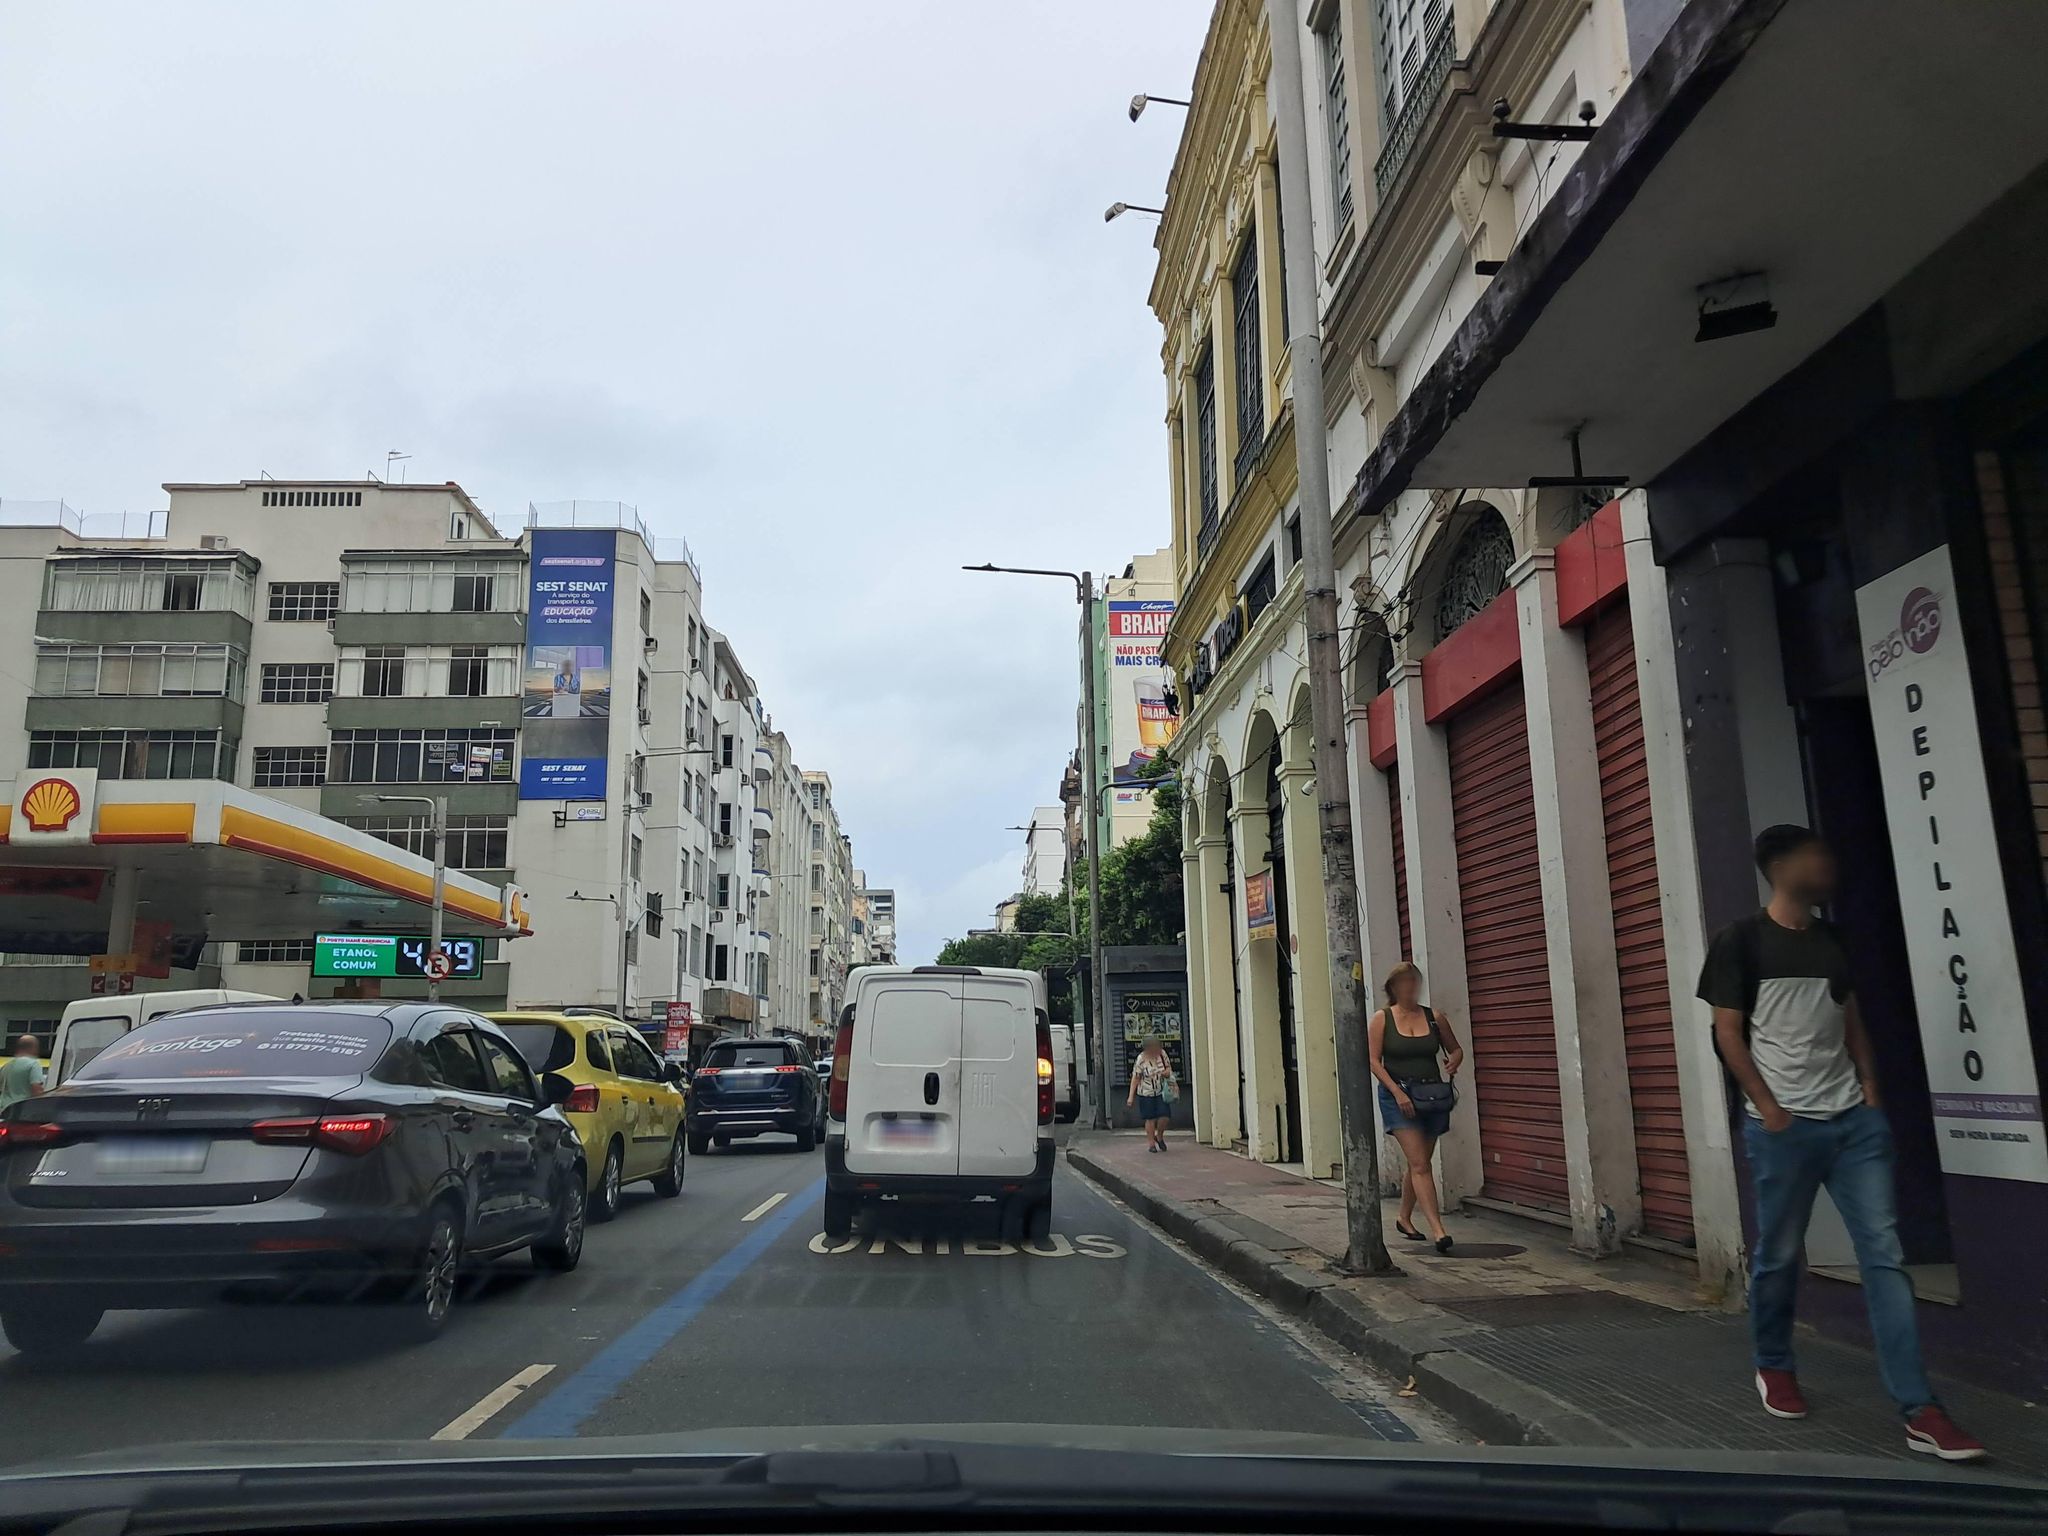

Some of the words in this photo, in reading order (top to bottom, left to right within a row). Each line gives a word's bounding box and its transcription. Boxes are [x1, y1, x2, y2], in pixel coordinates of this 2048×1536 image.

[536, 581, 566, 592] SEST
[568, 581, 608, 592] SENAT
[544, 606, 594, 617] EDUCAÇÃO
[1116, 644, 1133, 655] NÃO
[1115, 656, 1142, 666] MAIS
[541, 764, 561, 772] SEST
[1905, 683, 1984, 1082] DEPILAÇÃO
[333, 948, 378, 958] ETANOL
[333, 960, 376, 970] COMUM
[1141, 999, 1176, 1008] MIRANDA
